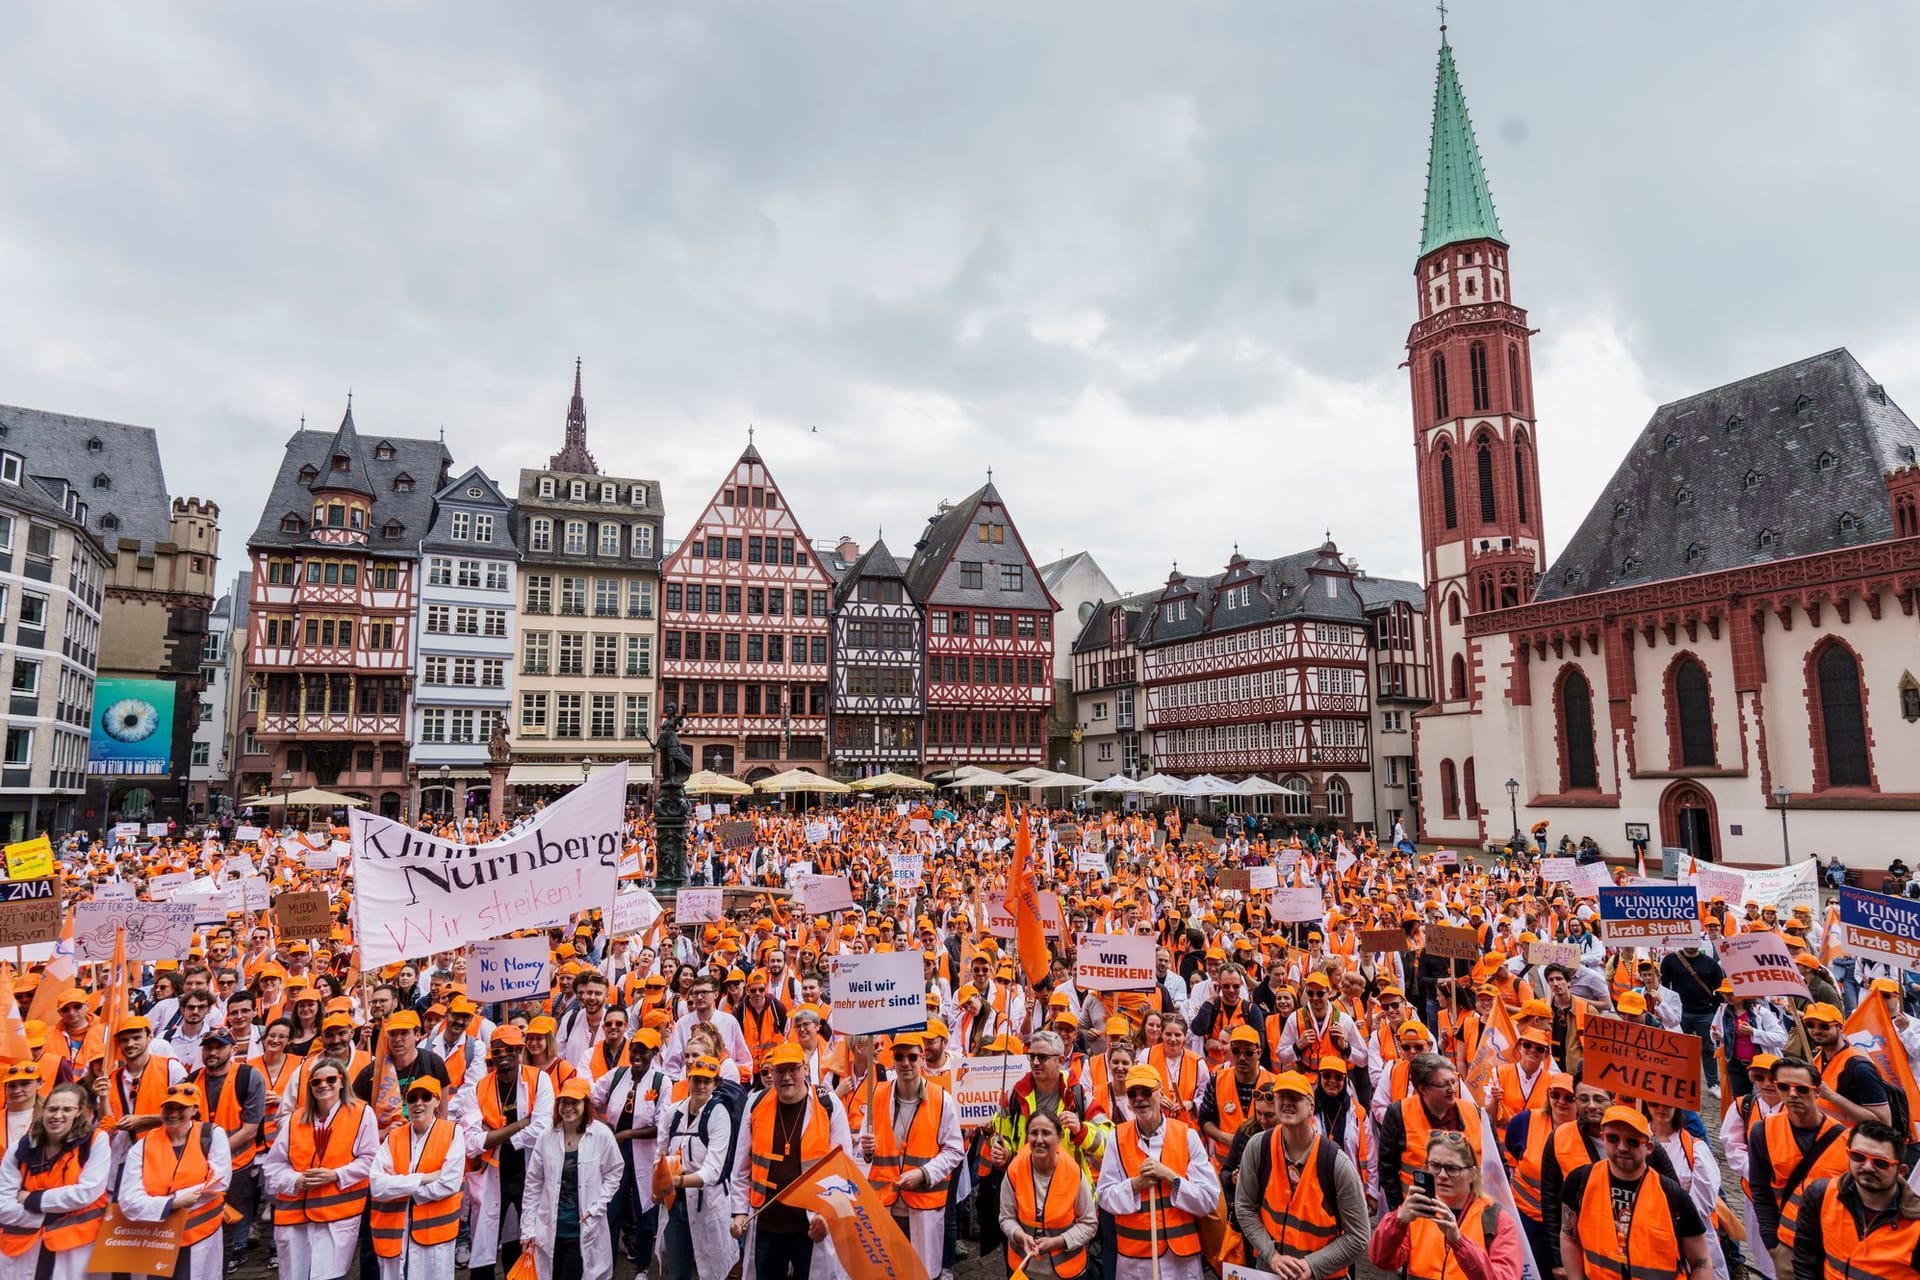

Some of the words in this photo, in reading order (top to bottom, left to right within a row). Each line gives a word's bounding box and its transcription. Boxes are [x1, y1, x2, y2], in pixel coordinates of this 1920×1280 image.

[517, 754, 566, 763] Souvenirs
[597, 754, 649, 763] Geschenke
[8, 880, 53, 901] ZNA
[79, 902, 106, 912] ARBEIT
[125, 902, 133, 912] 8
[162, 903, 197, 913] BEZAHLT
[1614, 895, 1695, 908] KLINIKUM
[288, 902, 318, 916] MUDDA
[384, 908, 462, 954] Wir
[478, 868, 582, 931] streiken!
[1625, 907, 1696, 919] COBURG
[1857, 900, 1920, 927] KLINIK
[1608, 922, 1645, 937] Ärzte
[1648, 920, 1691, 935] Streik
[1849, 928, 1892, 951] Ärzte
[1099, 953, 1128, 965] WIR
[1753, 954, 1792, 968] WIR
[504, 957, 544, 980] Money
[1079, 965, 1153, 980] STREIKEN!
[481, 980, 495, 993] No
[500, 978, 540, 993] Honey
[849, 980, 873, 993] Weil
[875, 979, 896, 991] wir
[834, 998, 857, 1009] mehr
[859, 997, 886, 1008] wert
[888, 994, 920, 1007] sind!
[1584, 1016, 1679, 1054] APPLAUS
[1589, 1042, 1629, 1057] zahlt
[1636, 1048, 1671, 1066] keine
[970, 1064, 1004, 1072] marburger
[1599, 1062, 1697, 1104] MIETE!
[956, 1091, 1002, 1105] QUALIT
[961, 1105, 997, 1118] IHREN
[114, 1226, 152, 1236] Gesunde
[105, 1237, 141, 1247] Gesunde
